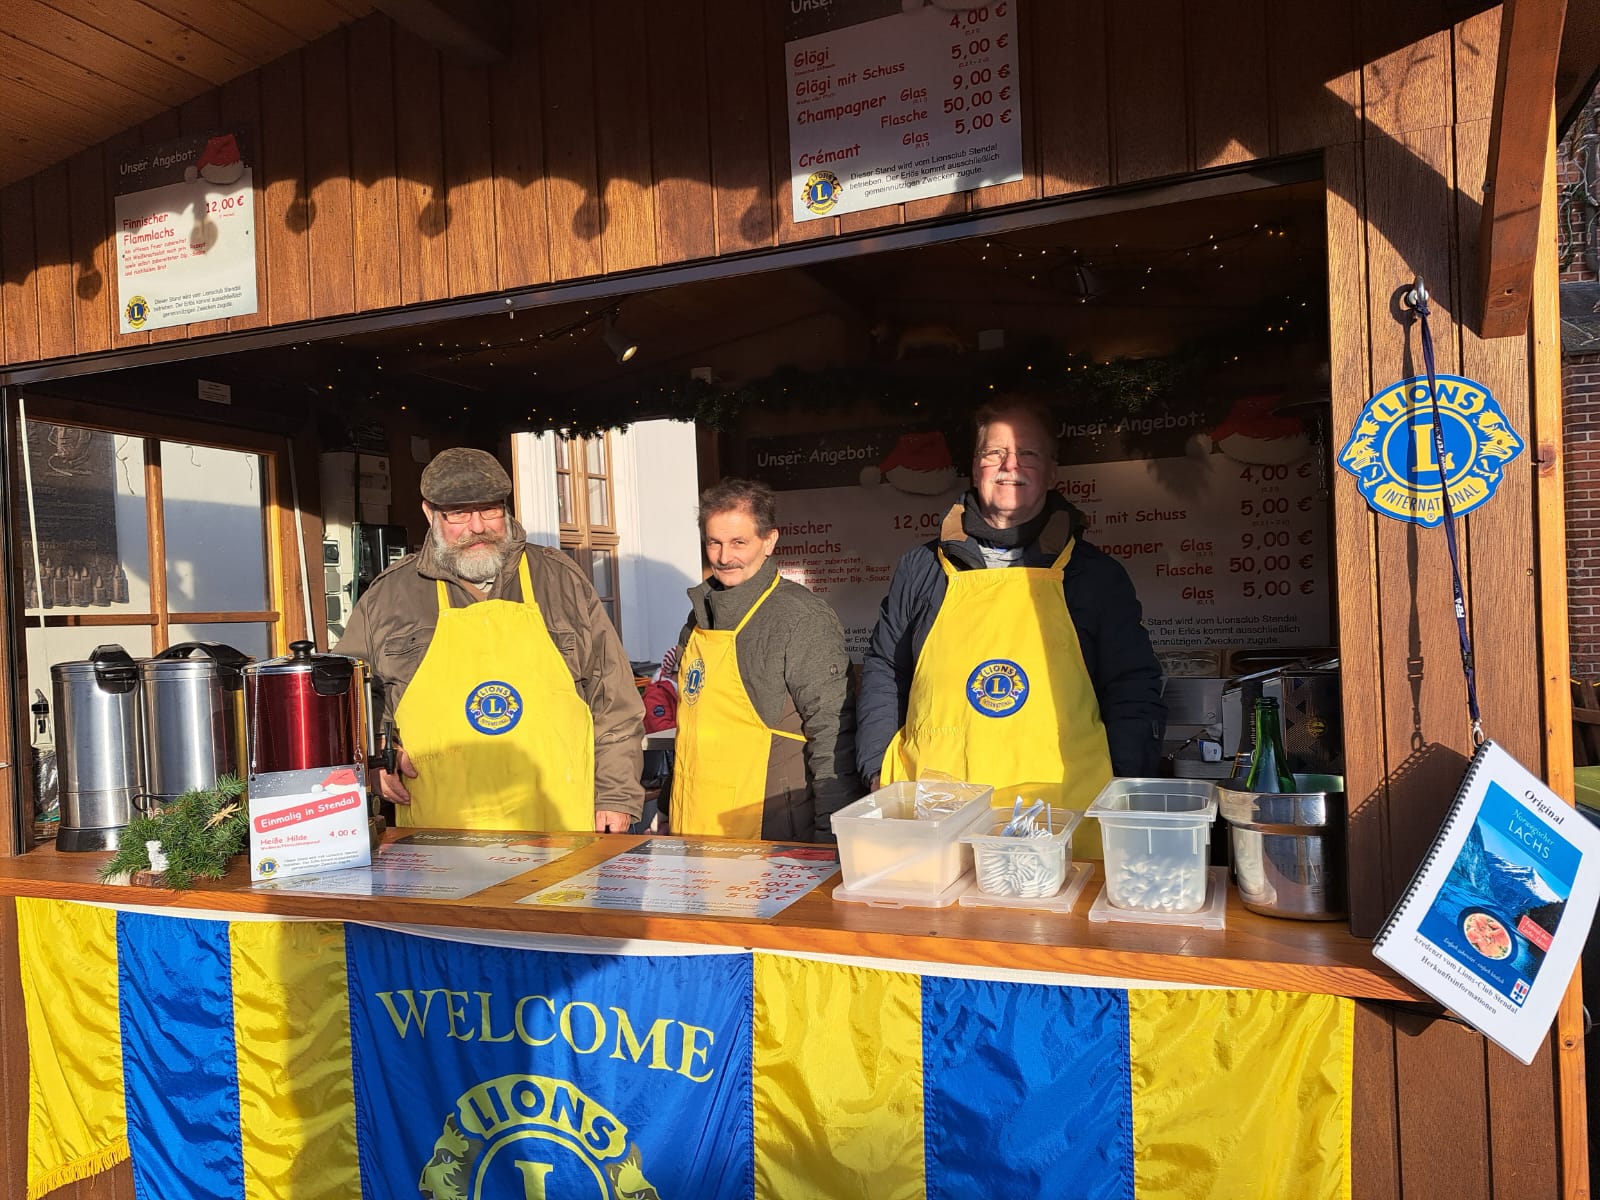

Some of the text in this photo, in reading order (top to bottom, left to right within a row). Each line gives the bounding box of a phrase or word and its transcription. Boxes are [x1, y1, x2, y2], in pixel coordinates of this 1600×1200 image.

[950, 2, 1007, 29] 4,00 €
[794, 33, 1008, 67] Glögi 5,00 €
[795, 63, 905, 97] Glögi mit Schuss
[797, 96, 886, 125] Champagner
[900, 87, 927, 101] Glas
[953, 68, 991, 90] 9,00
[998, 64, 1010, 78] €
[881, 86, 1010, 128] Flasche 50,00 €
[799, 109, 1012, 168] Crémant Glas 5,00 €
[120, 149, 197, 175] Unser Angebot:
[851, 171, 873, 180] Dieser
[875, 165, 896, 174] Stand
[898, 161, 913, 170] wird
[931, 151, 966, 164] Lionsclub
[969, 143, 998, 155] Stendal
[901, 170, 919, 179] Erlös
[921, 165, 945, 175] kommt
[947, 153, 1000, 169] ausschließlich
[957, 167, 984, 179] zugute.
[122, 195, 245, 231] Finnischer 12,00 €
[124, 228, 175, 246] Flammlachs
[1379, 384, 1479, 417] LIONS
[1120, 411, 1205, 435] Angebot:
[757, 445, 880, 467] Unser Angebot:
[1411, 424, 1456, 472] L
[1240, 462, 1312, 485] 4,00 €
[1055, 479, 1312, 518] Glögi 5,00 €
[1382, 484, 1481, 511] INTERNATONAL
[894, 512, 940, 531] 12,00
[1105, 511, 1128, 524] mit
[1135, 508, 1187, 522] Schuss
[773, 540, 841, 557] ammlachs
[1102, 530, 1312, 559] pagner Glas 9,00 €
[1155, 554, 1314, 577] Flasche 50,00 €
[1182, 580, 1315, 600] Glas 5,00 €
[1147, 617, 1173, 626] Stand
[1175, 617, 1193, 625] wird
[1217, 615, 1260, 624] Lionsclub
[1262, 614, 1297, 623] Stendal
[1178, 627, 1200, 635] Erlös
[1203, 627, 1233, 635] kommt
[1236, 625, 1300, 634] ausschließlich
[1204, 637, 1244, 645] Zwecken
[1246, 637, 1280, 646] zugute.
[984, 665, 1014, 675] LIONS
[480, 687, 508, 696] LIONS
[991, 678, 1006, 694] L
[489, 698, 502, 713] L
[261, 796, 355, 828] Einmalig in Stendal
[1525, 790, 1564, 825] Original
[261, 836, 283, 845] Heiße
[287, 833, 308, 842] Hilde
[329, 829, 348, 838] 4,00
[1508, 819, 1550, 859] LACHS
[1512, 809, 1554, 846] Norwegischer
[586, 873, 680, 881] Champagner
[602, 864, 641, 872] Glögi
[726, 885, 779, 893] 50,00
[1414, 935, 1518, 1015] kredenzt vom Lions-Club Stendal
[1420, 955, 1497, 1015] Herkunftsinformationen
[375, 988, 715, 1083] WELCOME
[468, 1079, 616, 1151] LIONS
